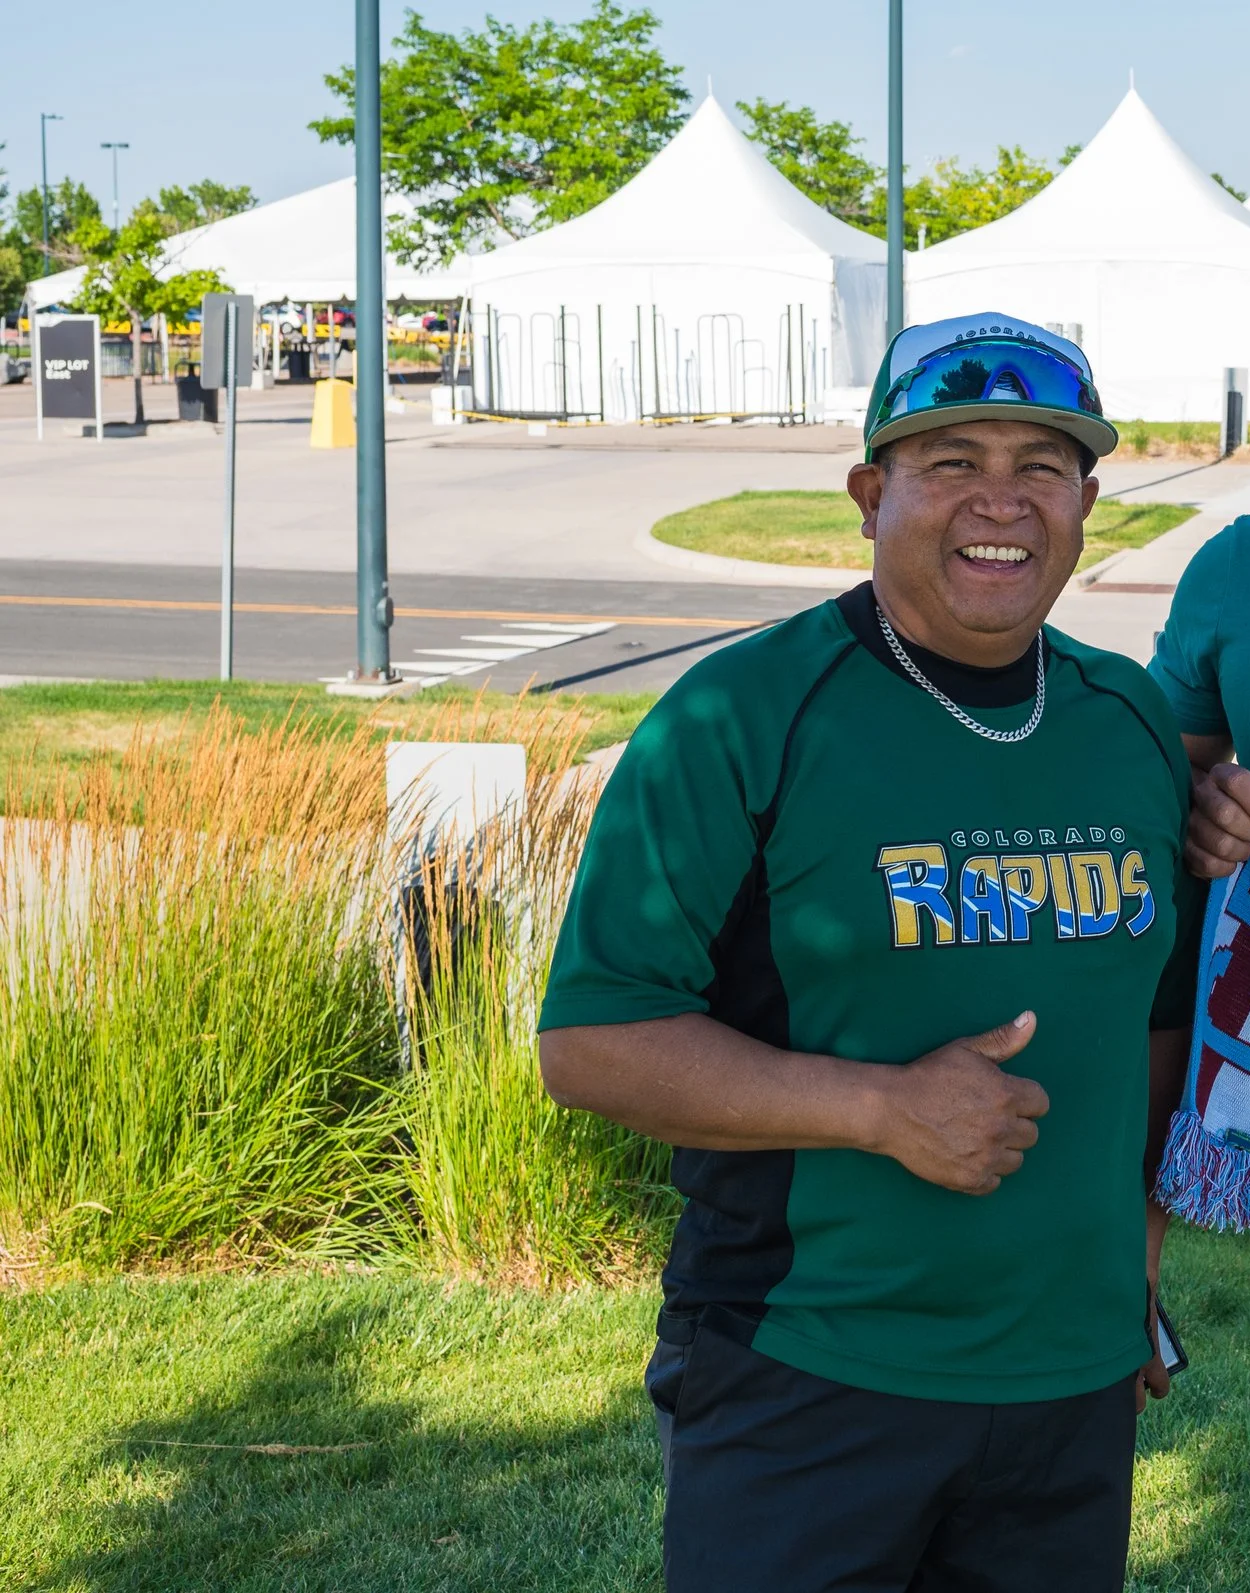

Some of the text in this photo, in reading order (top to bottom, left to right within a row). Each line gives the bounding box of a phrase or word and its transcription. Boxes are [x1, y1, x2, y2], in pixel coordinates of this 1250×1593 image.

[955, 326, 1046, 346] COLORAD
[45, 359, 89, 371] VIP LOT
[950, 827, 1127, 848] COLORADO
[877, 843, 1156, 948] RAPIDS
